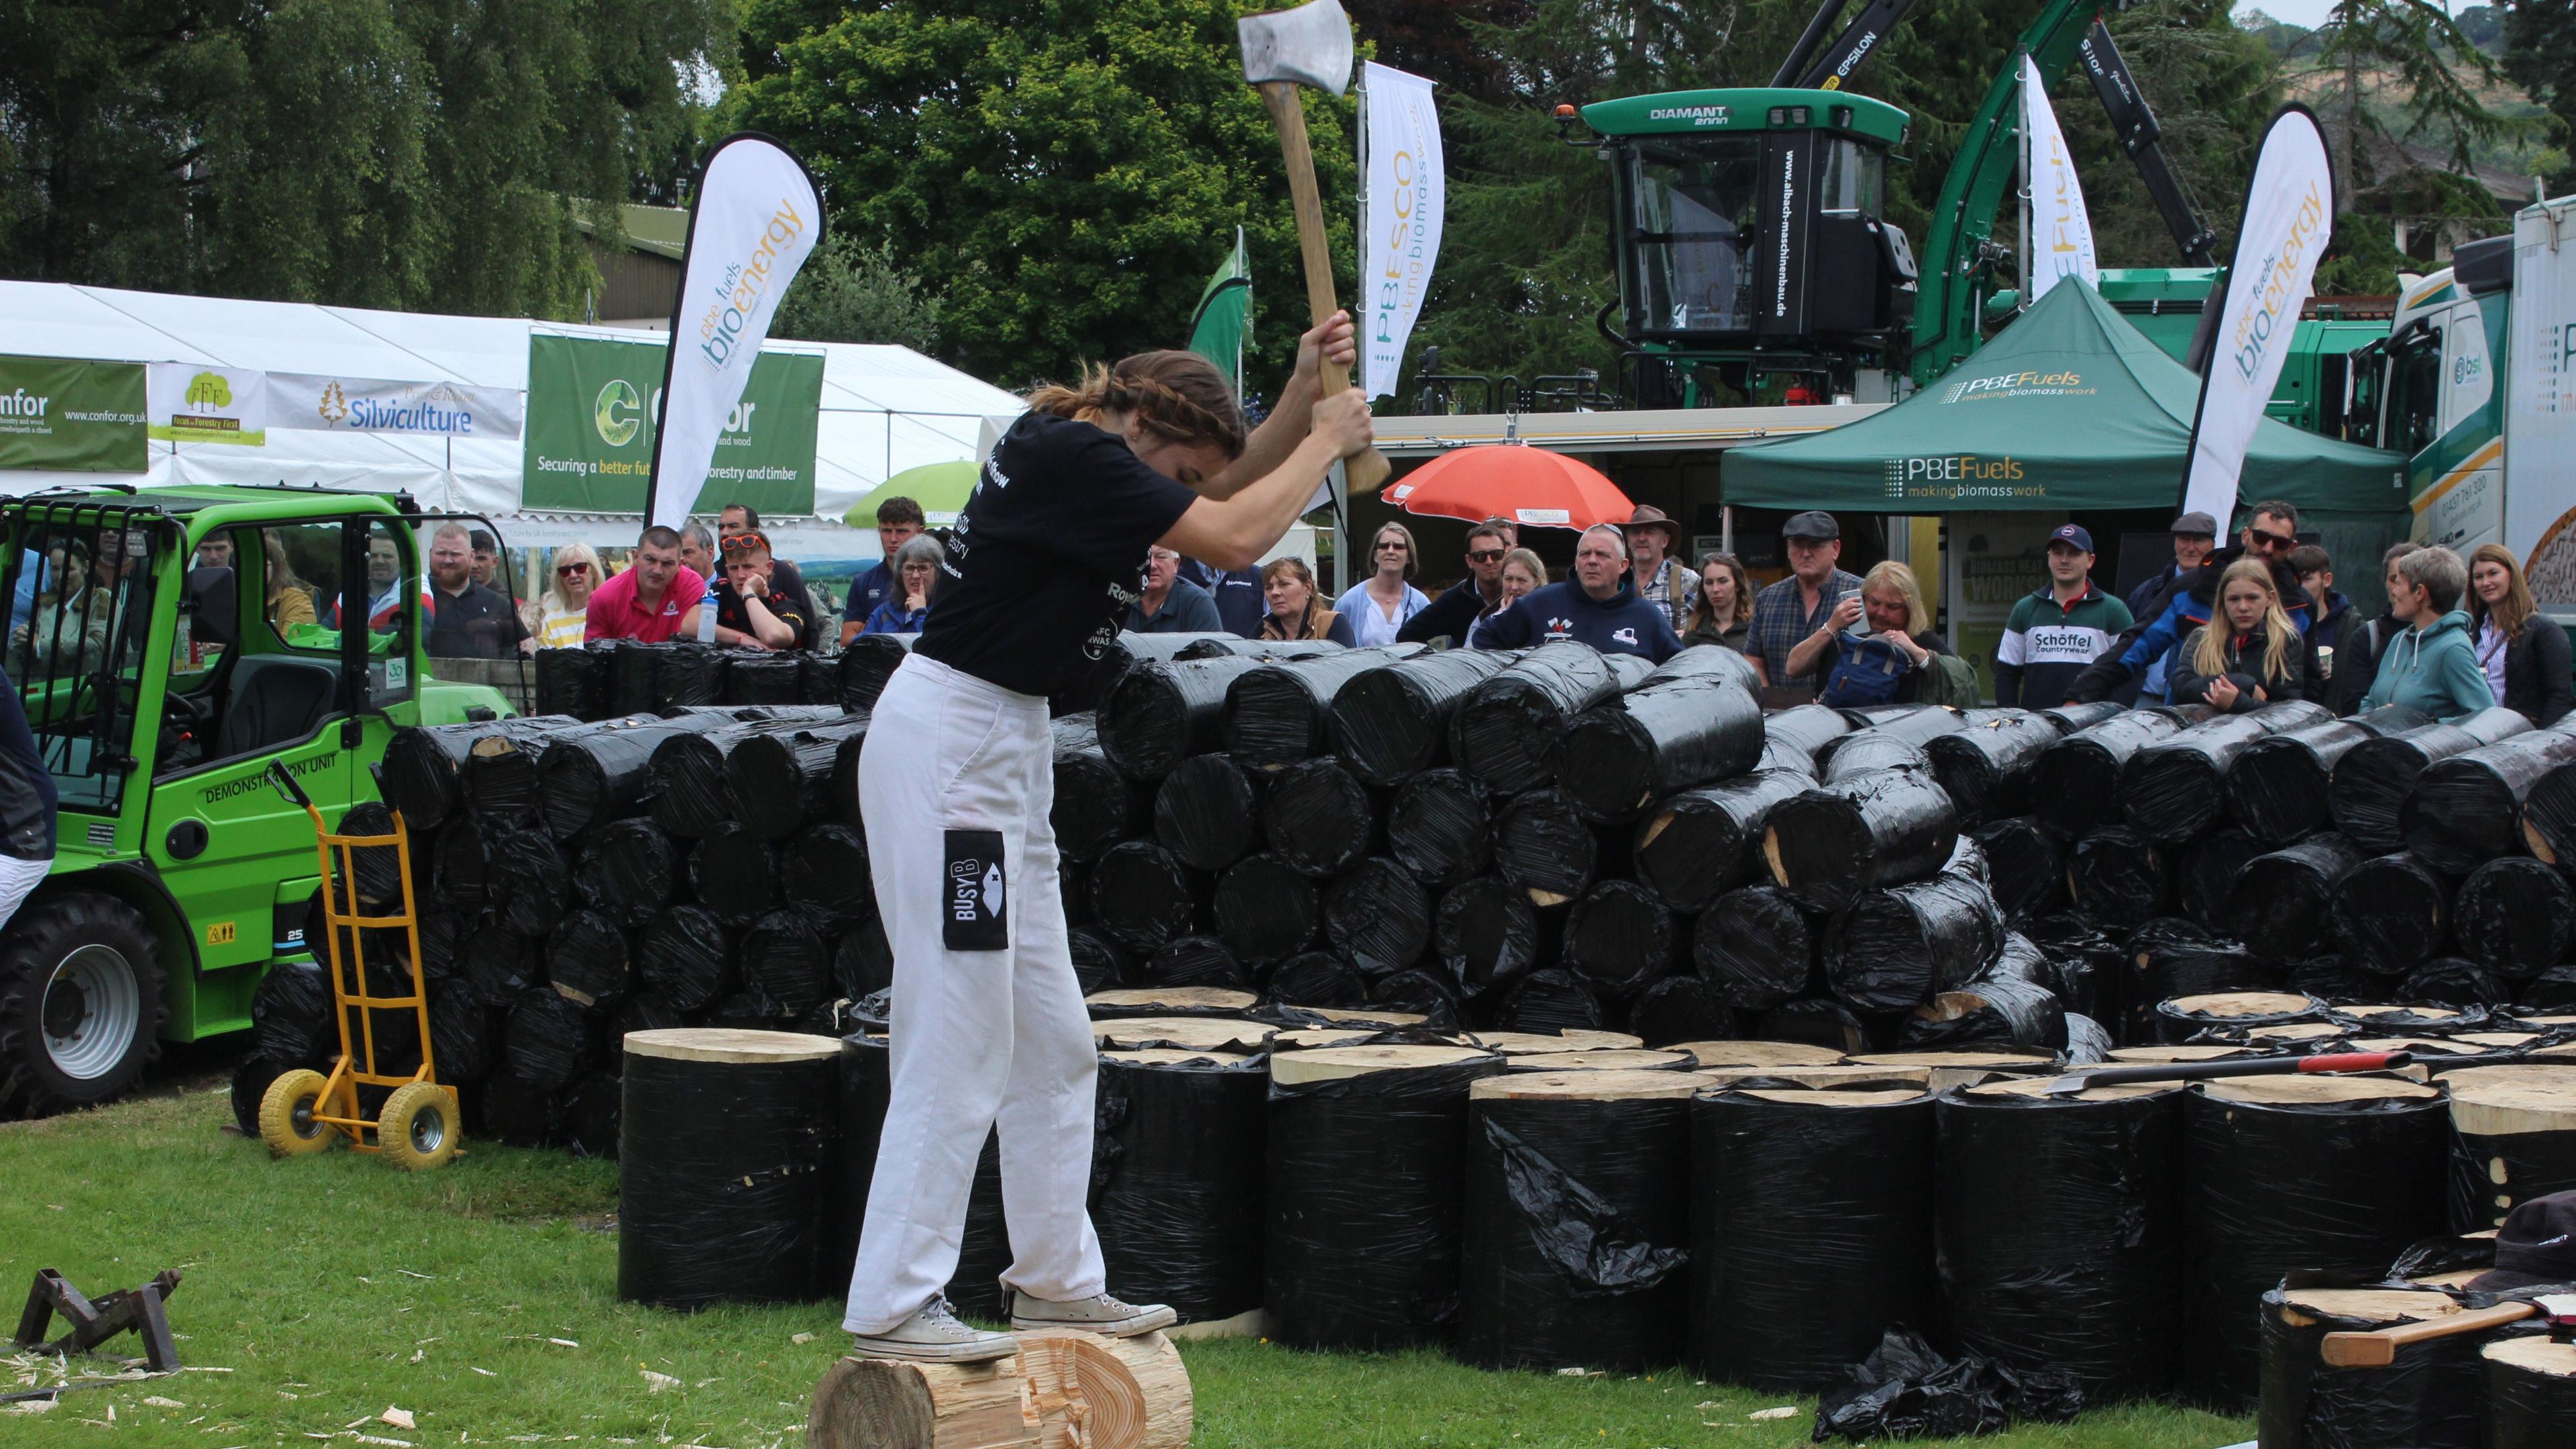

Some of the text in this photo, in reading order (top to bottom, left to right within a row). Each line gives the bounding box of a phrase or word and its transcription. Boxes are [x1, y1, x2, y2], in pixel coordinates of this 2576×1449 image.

[1837, 31, 1876, 76] EPSILON
[1777, 149, 1794, 317] www.albach-maschinenbau.de
[1377, 150, 1413, 343] PBESCO
[701, 198, 804, 366] bioenergy
[2235, 180, 2324, 380] bioenergy
[2252, 252, 2275, 301] fuels
[700, 262, 741, 341] pbe fuels
[431, 386, 443, 400] &
[1962, 386, 2097, 402] makingbiomasswork
[1968, 371, 2081, 393] PBEFuels
[0, 388, 49, 416] nfor
[65, 411, 147, 426] www.confor.org.uk
[173, 416, 190, 425] Focus
[195, 418, 221, 429] Forestry
[223, 419, 237, 429] First
[350, 398, 472, 433] Silviculture
[718, 435, 751, 446] and wood
[538, 456, 797, 482] Securing a better fut orestry and timber
[1909, 457, 2023, 480] PBEFuels
[1909, 484, 2046, 499] makingbiomasswork
[2473, 475, 2487, 494] 320
[949, 536, 969, 559] estry
[2036, 646, 2089, 654] Countrywear
[206, 754, 335, 804] DEMONSTRAON UNIT
